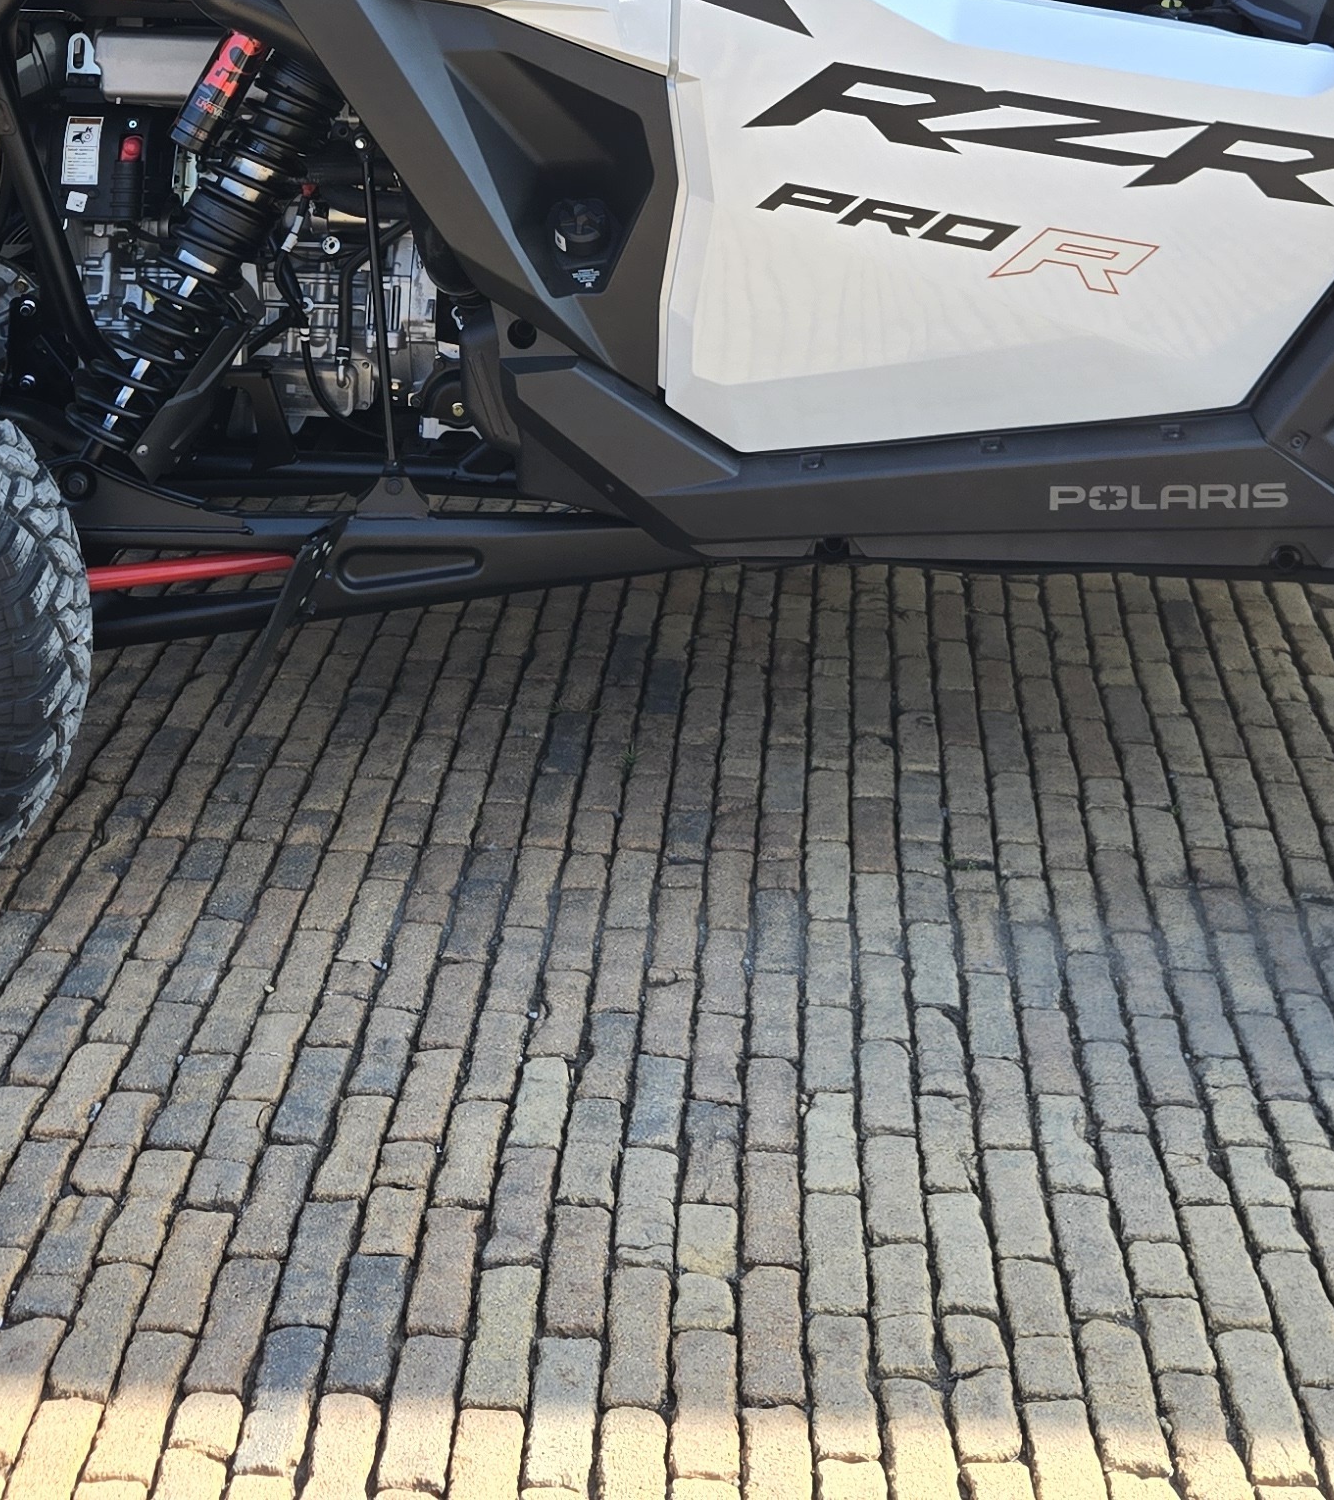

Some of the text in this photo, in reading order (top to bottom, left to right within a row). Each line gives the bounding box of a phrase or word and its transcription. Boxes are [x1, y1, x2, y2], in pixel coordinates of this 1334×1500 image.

[202, 28, 264, 98] FO
[756, 182, 1160, 295] PRO R
[1049, 482, 1289, 512] POLARIS
